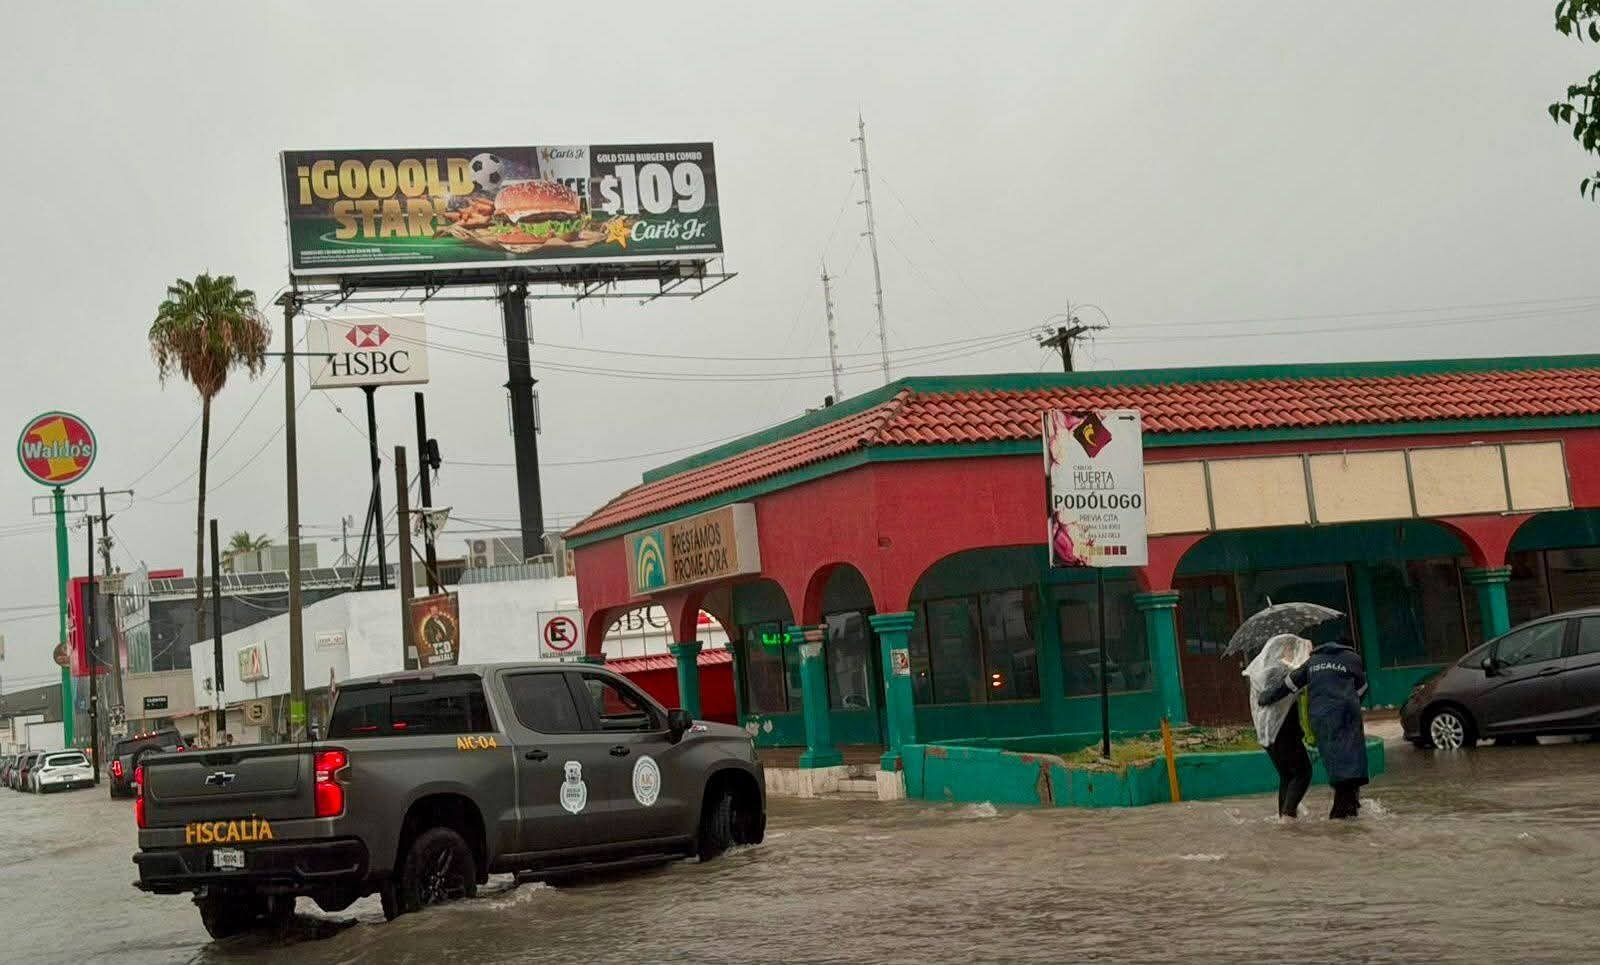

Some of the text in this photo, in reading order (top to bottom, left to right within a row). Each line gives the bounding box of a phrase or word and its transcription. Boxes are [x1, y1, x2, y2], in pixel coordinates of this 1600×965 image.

[597, 151, 703, 163] GOLD STAR BURGER EN COMBO
[599, 162, 706, 216] $109
[630, 219, 706, 242] Carl's Jr.
[331, 350, 410, 377] HSBC
[24, 439, 92, 459] Waldo's
[1073, 472, 1114, 484] HUERTA
[1054, 491, 1142, 510] PODÓLOGO
[1079, 513, 1119, 523] PREVIA CITA
[673, 546, 729, 582] PROMEJORA
[456, 735, 497, 750] AIC-04
[185, 813, 273, 844] FISCALÍA
